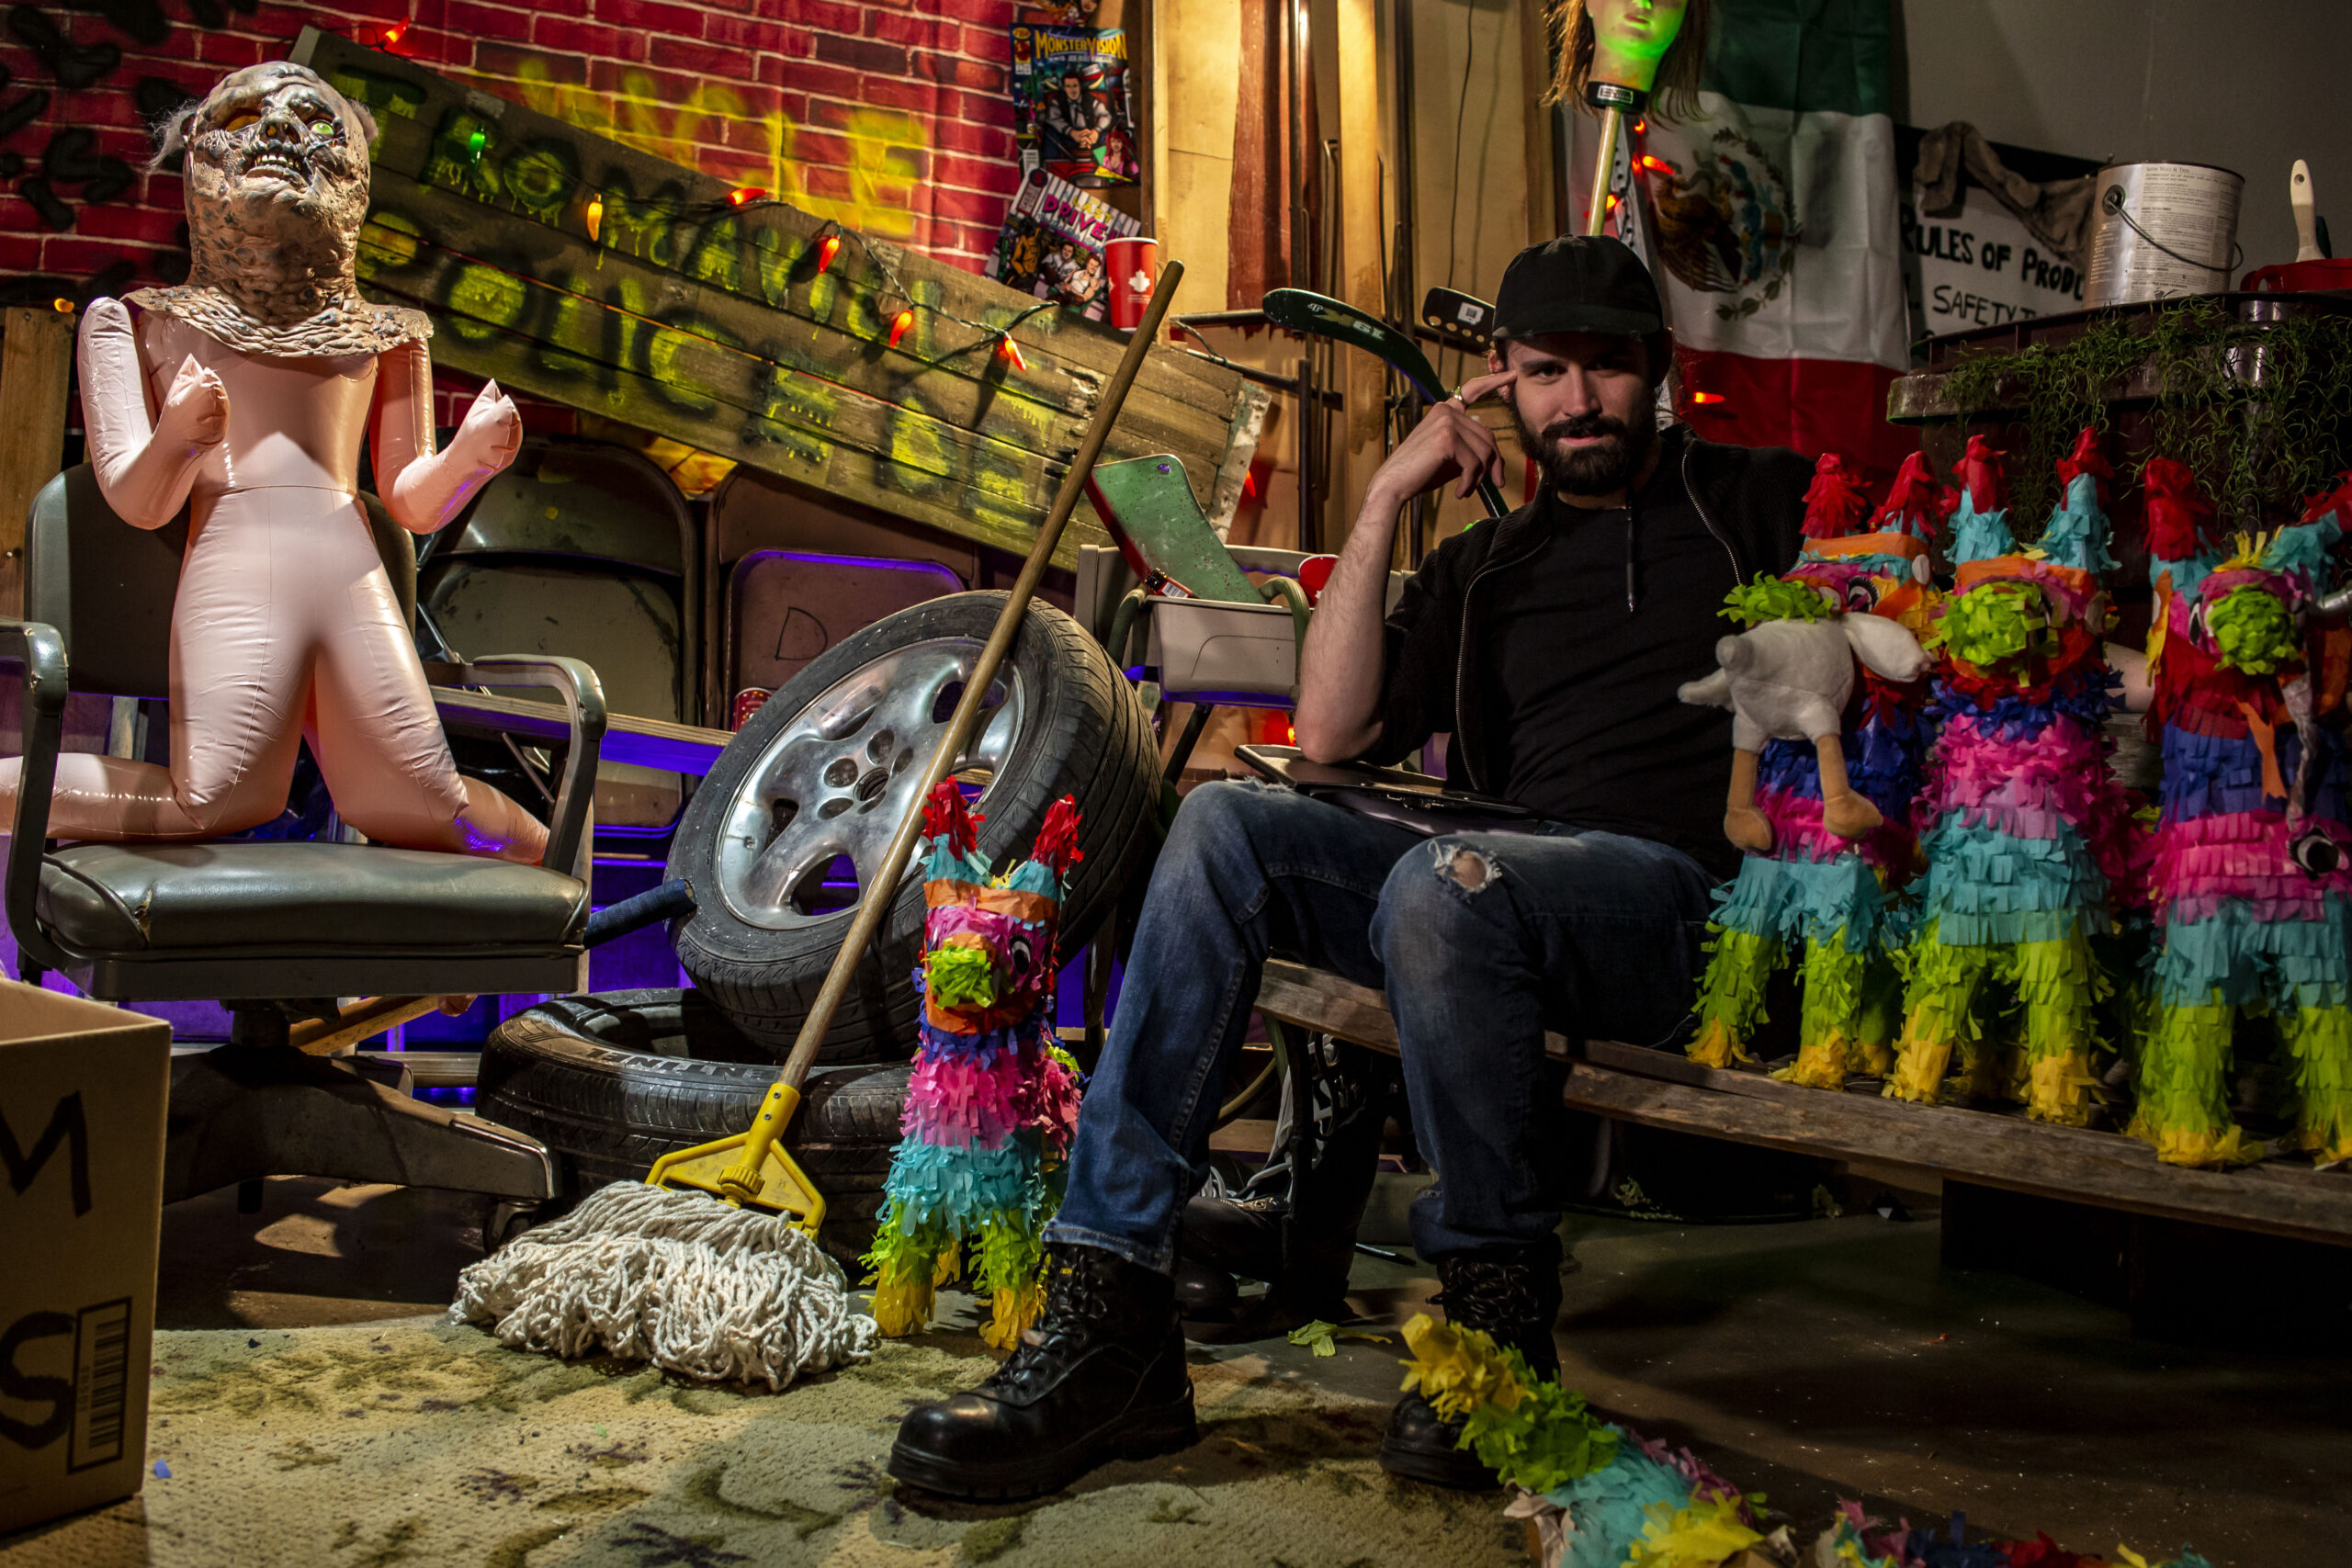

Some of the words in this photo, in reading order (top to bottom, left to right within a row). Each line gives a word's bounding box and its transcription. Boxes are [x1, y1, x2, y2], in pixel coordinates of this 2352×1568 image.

[1072, 196, 1114, 223] LAST
[1900, 202, 1974, 265] RULES
[1981, 243, 2012, 272] OF
[1932, 285, 2017, 326] SAFETY
[586, 1047, 779, 1080] ENTINEL
